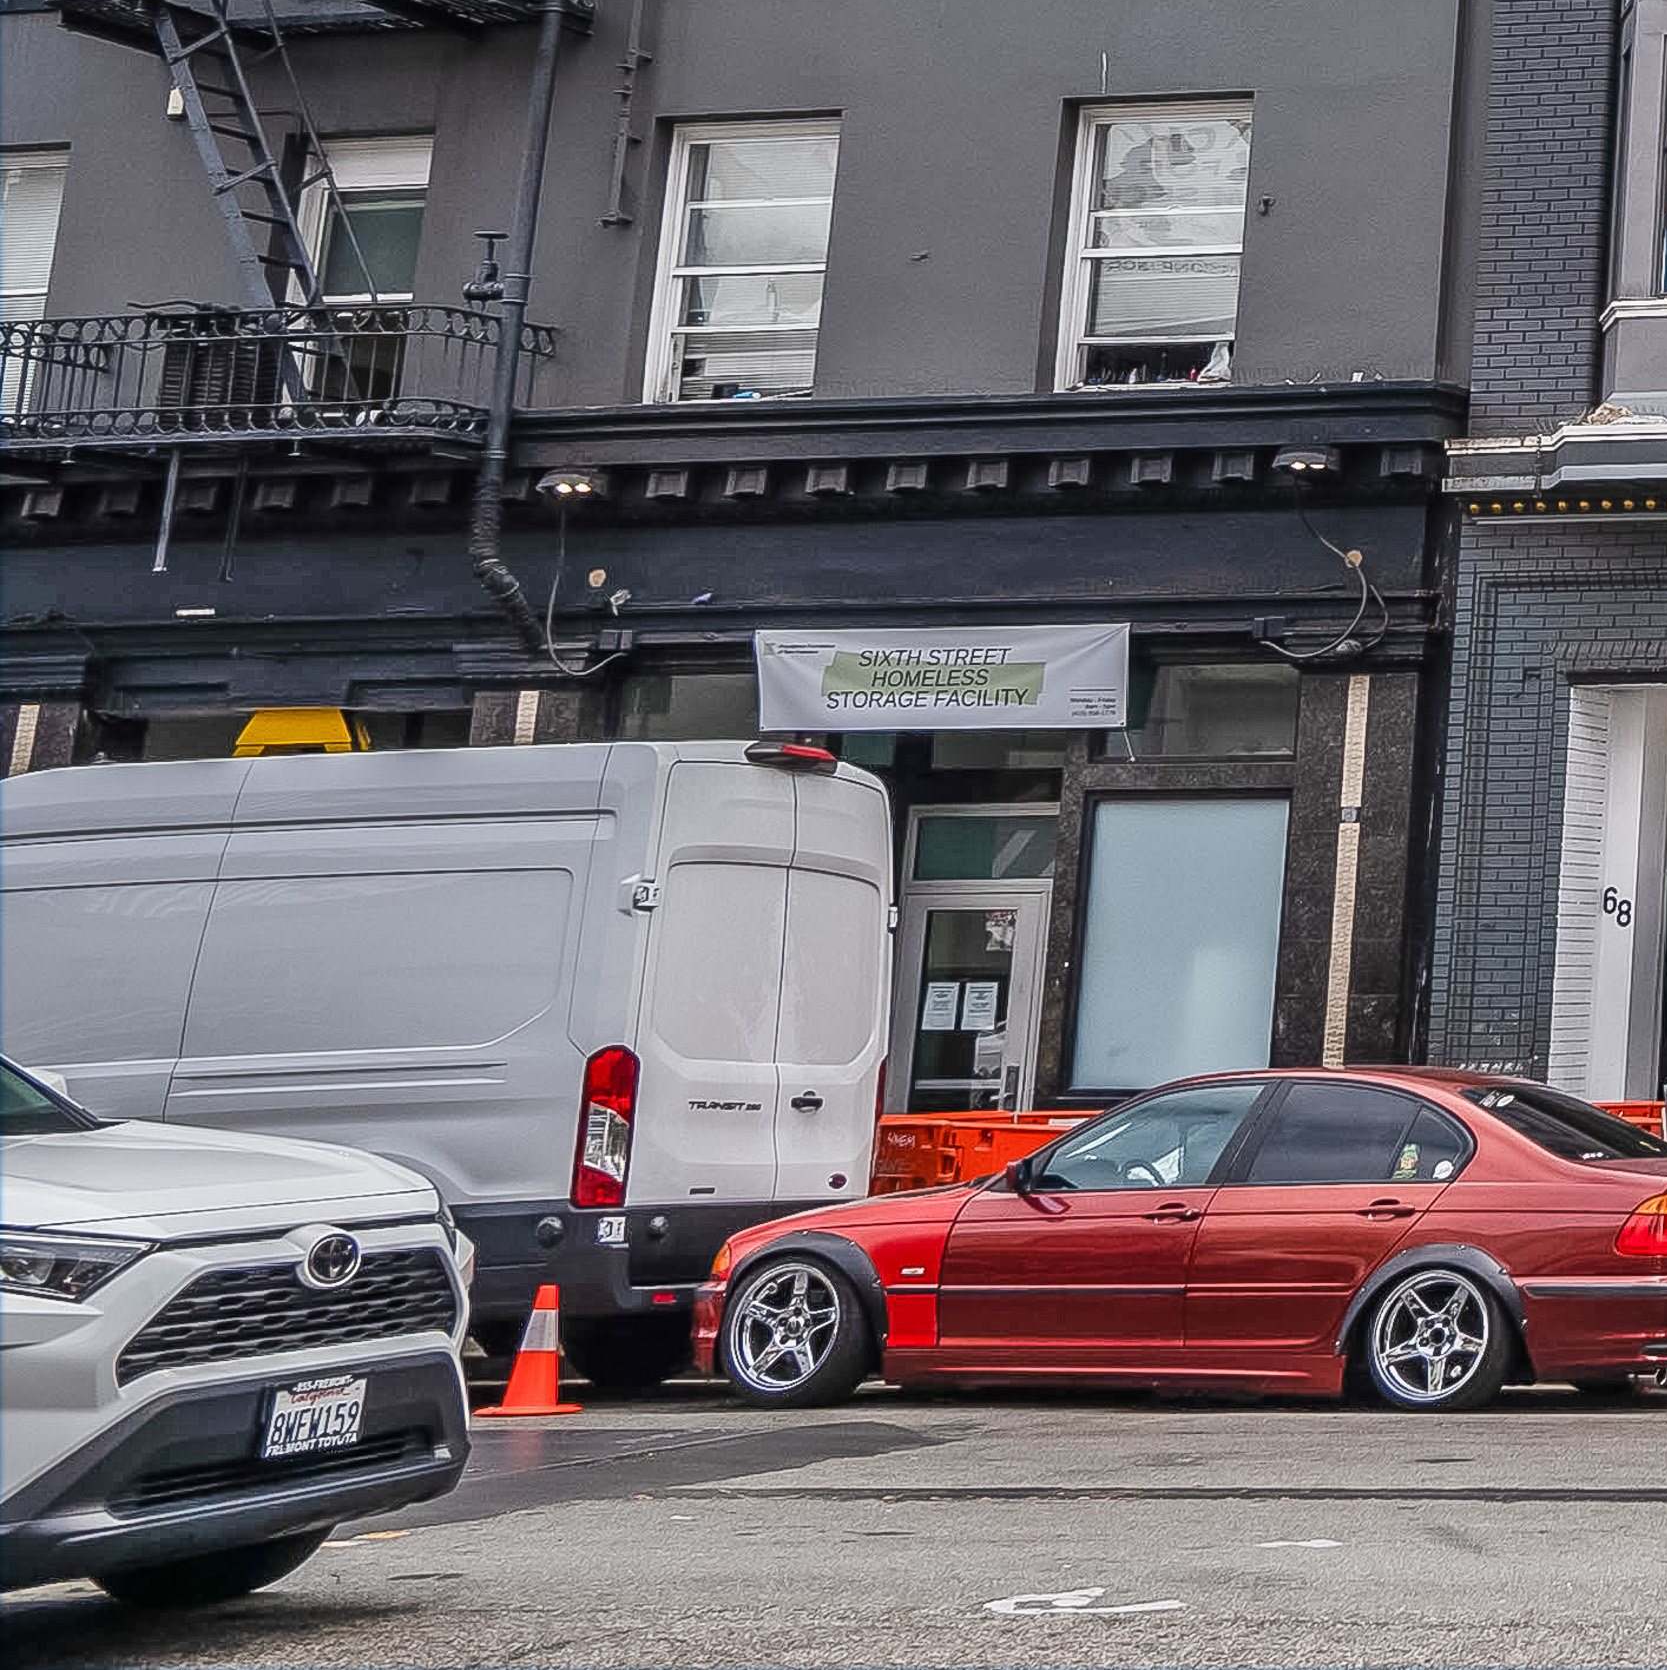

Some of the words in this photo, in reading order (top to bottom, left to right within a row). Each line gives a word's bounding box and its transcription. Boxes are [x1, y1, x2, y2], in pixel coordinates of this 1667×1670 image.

[858, 649, 922, 667] SIXTH
[926, 648, 1011, 666] STREET
[871, 669, 988, 687] HOMELESS
[827, 691, 929, 709] STORAGE
[934, 688, 1029, 707] FACILITY
[1603, 886, 1631, 927] 68
[688, 1101, 745, 1110] TRANSIT
